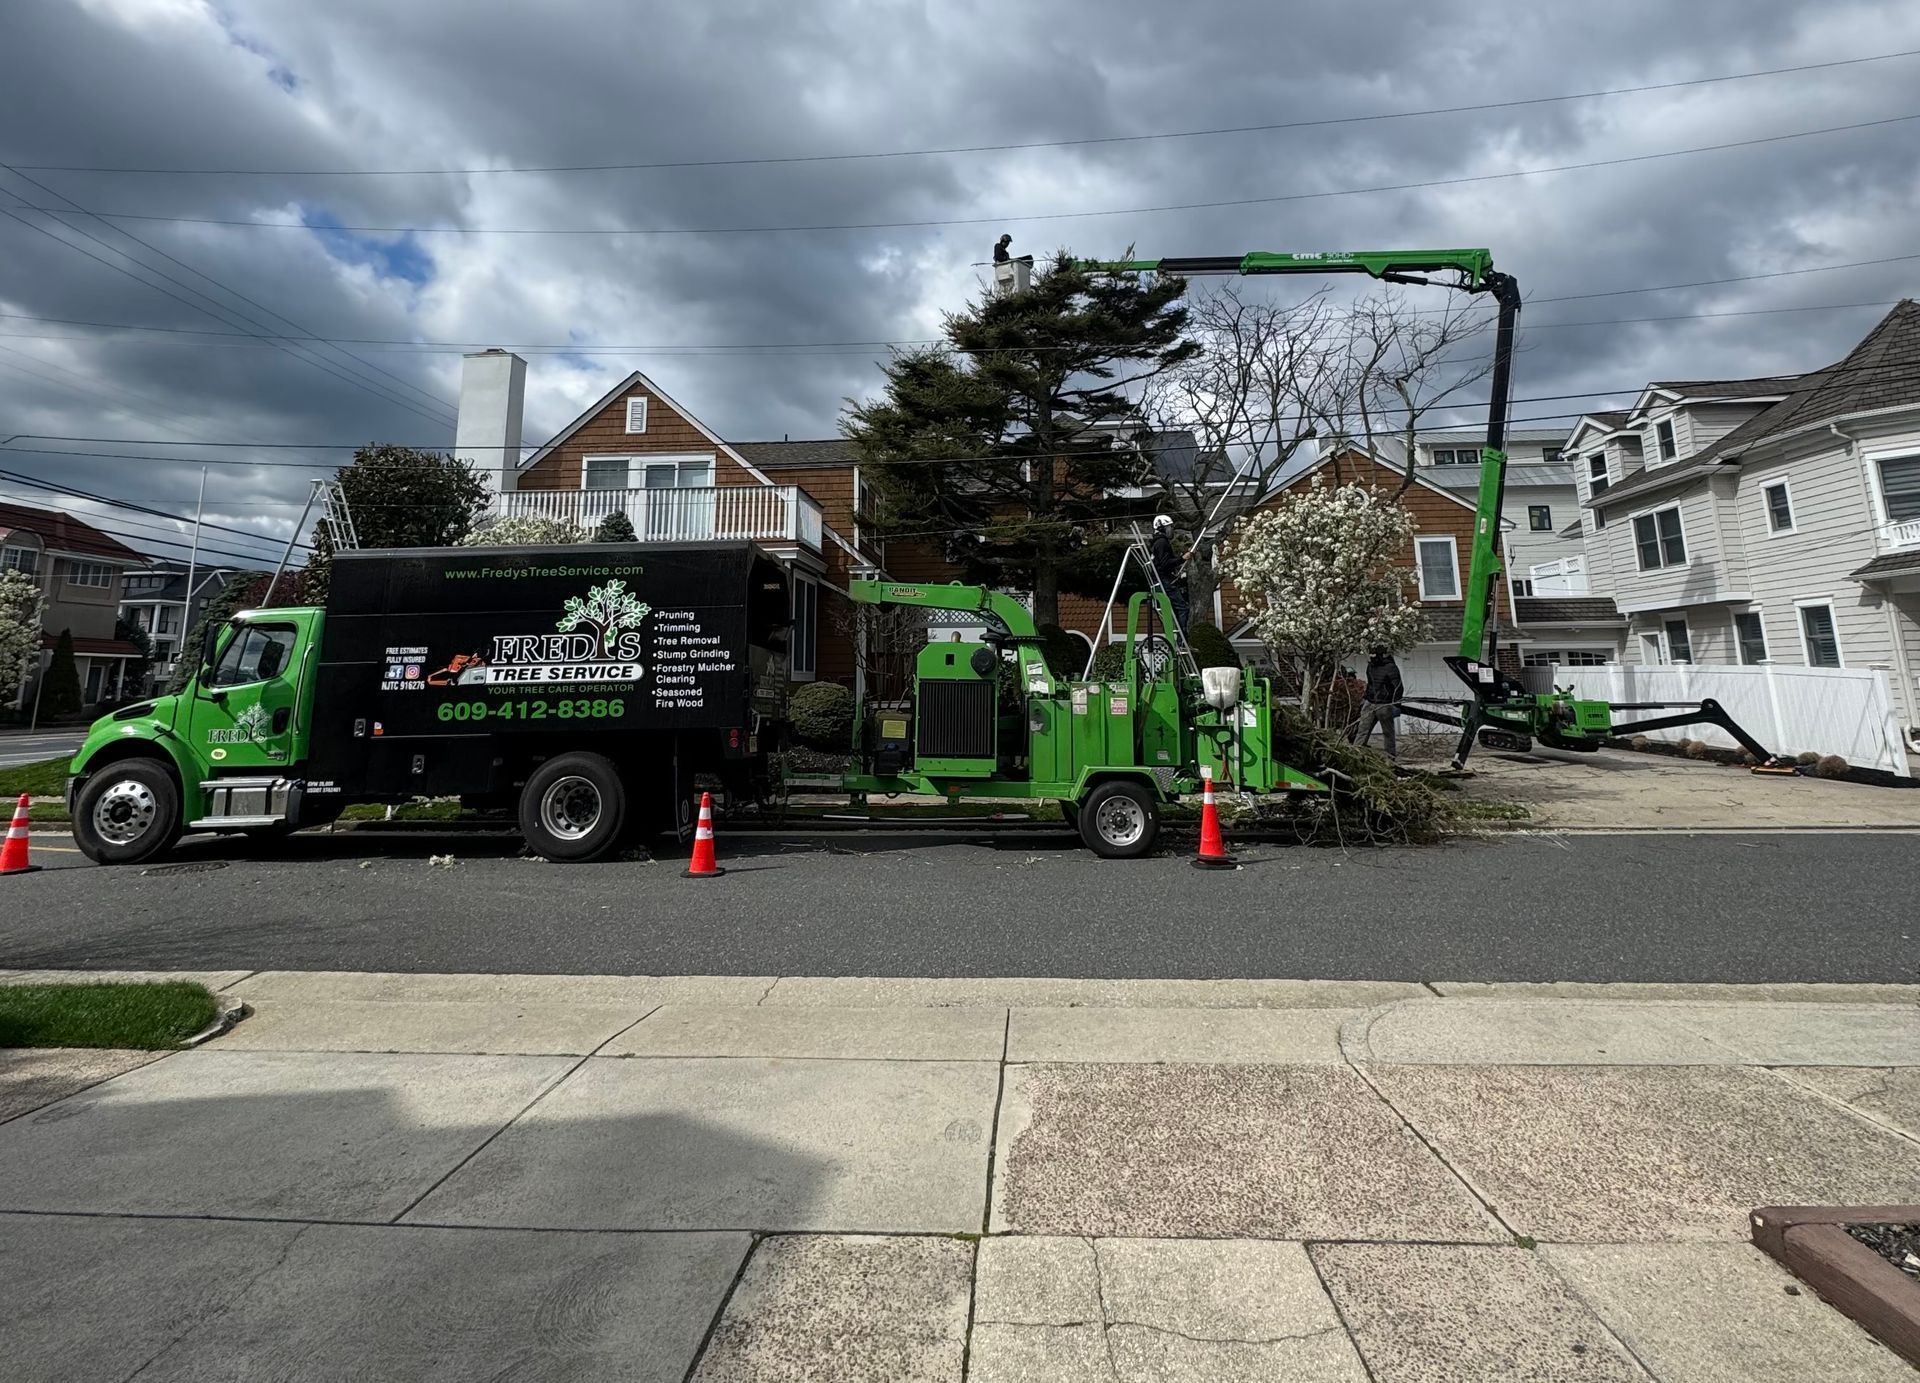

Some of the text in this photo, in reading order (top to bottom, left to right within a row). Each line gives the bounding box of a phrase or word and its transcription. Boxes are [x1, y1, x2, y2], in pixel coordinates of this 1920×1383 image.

[445, 565, 644, 580] www.FredysTreeService.com
[659, 610, 695, 620] Pruning
[658, 623, 701, 633] Trimming
[658, 636, 720, 645] Tree Removal
[657, 649, 730, 660] Stump Grinding
[656, 662, 735, 673] Forestry Mulcher
[492, 665, 634, 681] TREE SERVICE
[656, 675, 695, 685] Clearing
[381, 681, 399, 690] NJTC
[488, 684, 634, 695] YOUR TREE CARE OPERATOR
[656, 687, 702, 697] Seasoned
[656, 698, 703, 708] Fire Wood
[437, 699, 625, 721] 609-412-8386
